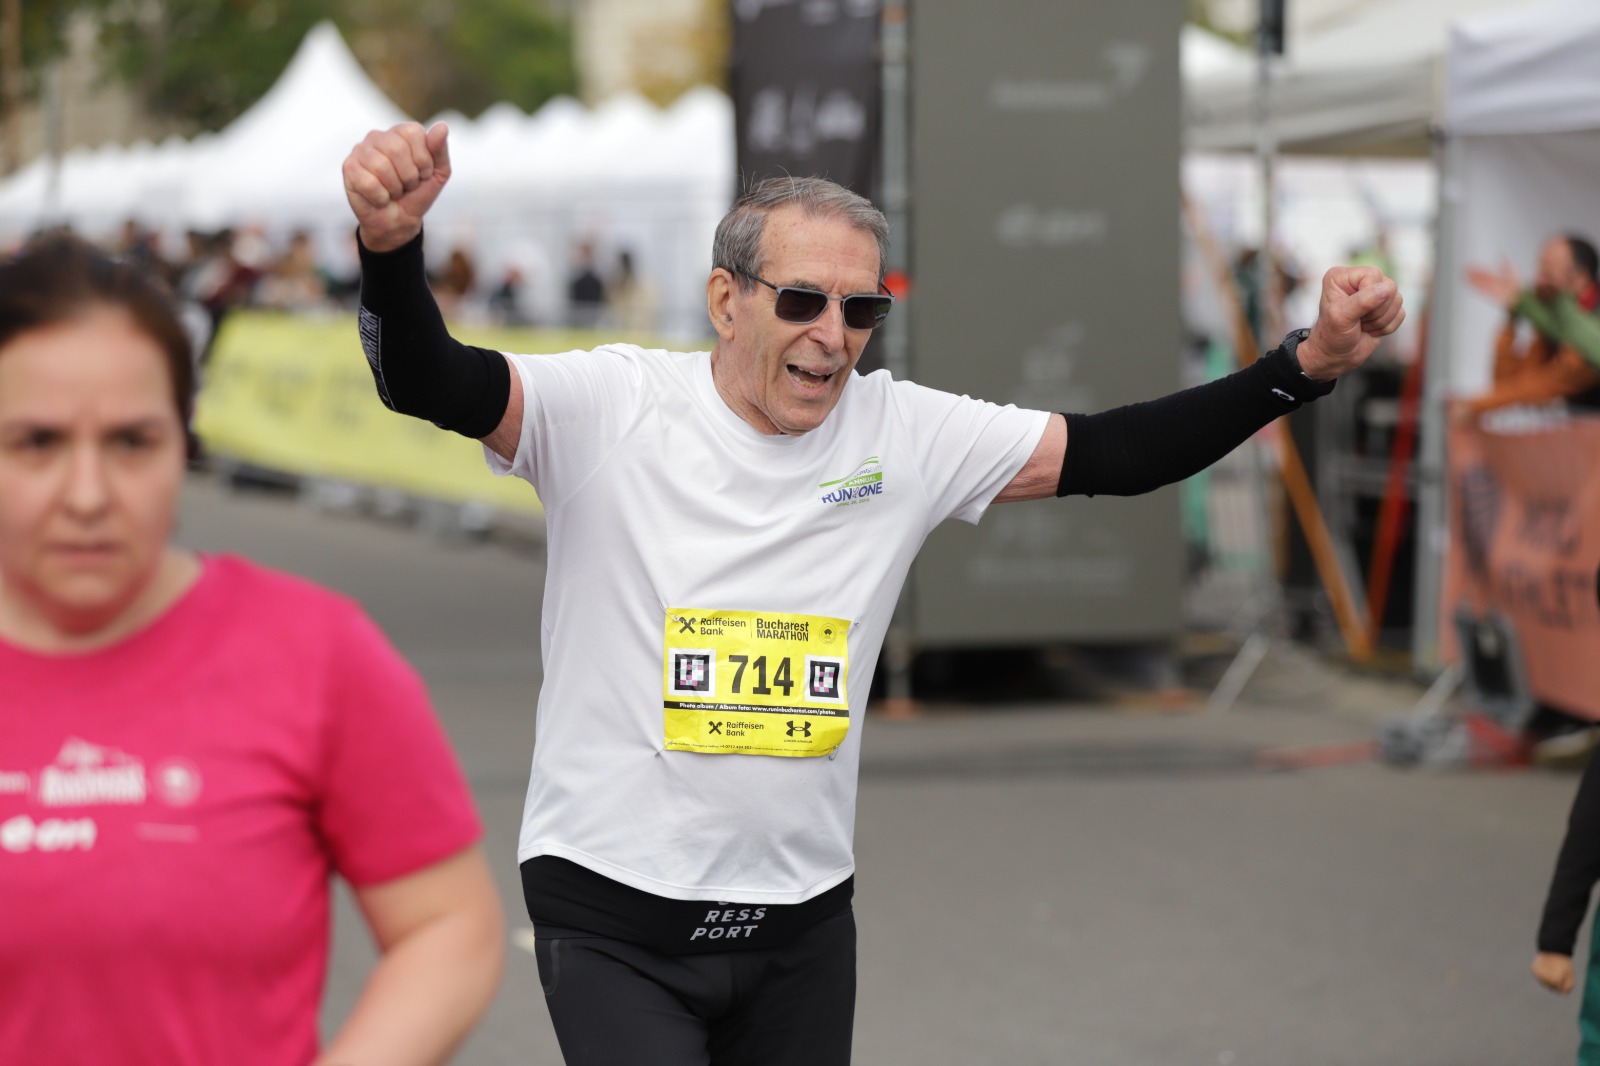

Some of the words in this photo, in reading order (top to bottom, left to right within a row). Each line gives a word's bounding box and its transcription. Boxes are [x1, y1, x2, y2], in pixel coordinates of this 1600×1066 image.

[821, 488, 853, 503] RUN
[858, 482, 883, 498] ONE
[700, 618, 746, 628] Raiffeisen
[756, 618, 809, 632] Bucharest
[700, 627, 724, 636] Bank
[756, 630, 809, 642] MARATHON
[728, 654, 794, 696] 714
[726, 721, 764, 730] Raiffeisen
[726, 729, 745, 737] Bank
[704, 908, 767, 923] RESS
[689, 925, 758, 940] PORT
